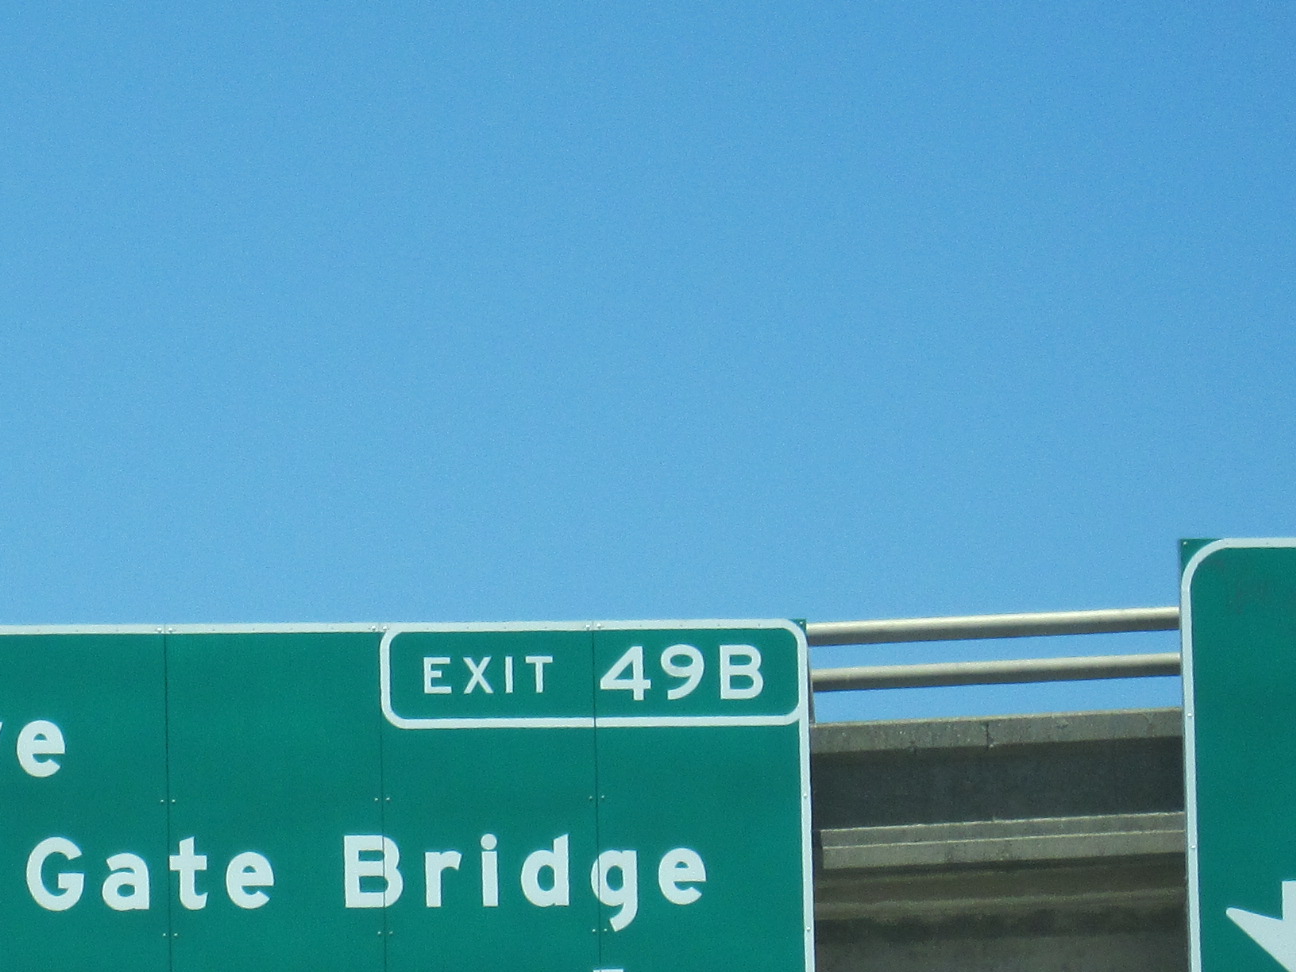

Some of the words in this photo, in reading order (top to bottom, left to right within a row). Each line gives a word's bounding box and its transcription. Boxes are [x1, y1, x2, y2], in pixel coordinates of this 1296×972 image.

[424, 656, 552, 693] EXIT
[600, 644, 763, 700] 49B
[27, 837, 274, 911] Gate
[344, 834, 706, 931] Bridge
